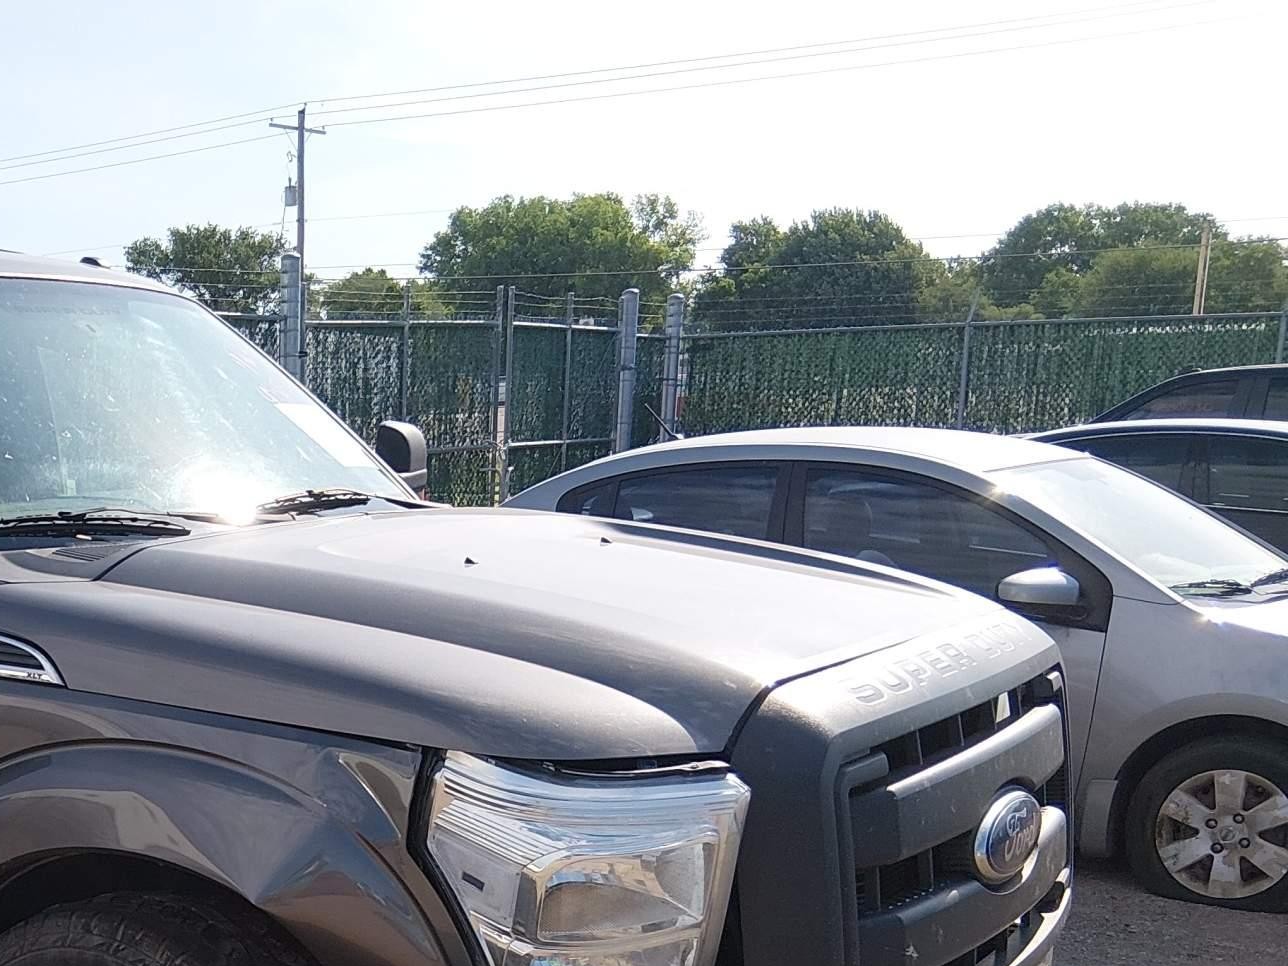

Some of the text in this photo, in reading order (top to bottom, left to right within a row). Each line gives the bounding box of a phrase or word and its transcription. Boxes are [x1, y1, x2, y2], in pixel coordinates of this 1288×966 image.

[26, 671, 43, 680] XLT
[843, 642, 977, 705] SUPER
[1005, 807, 1037, 862] Ford
